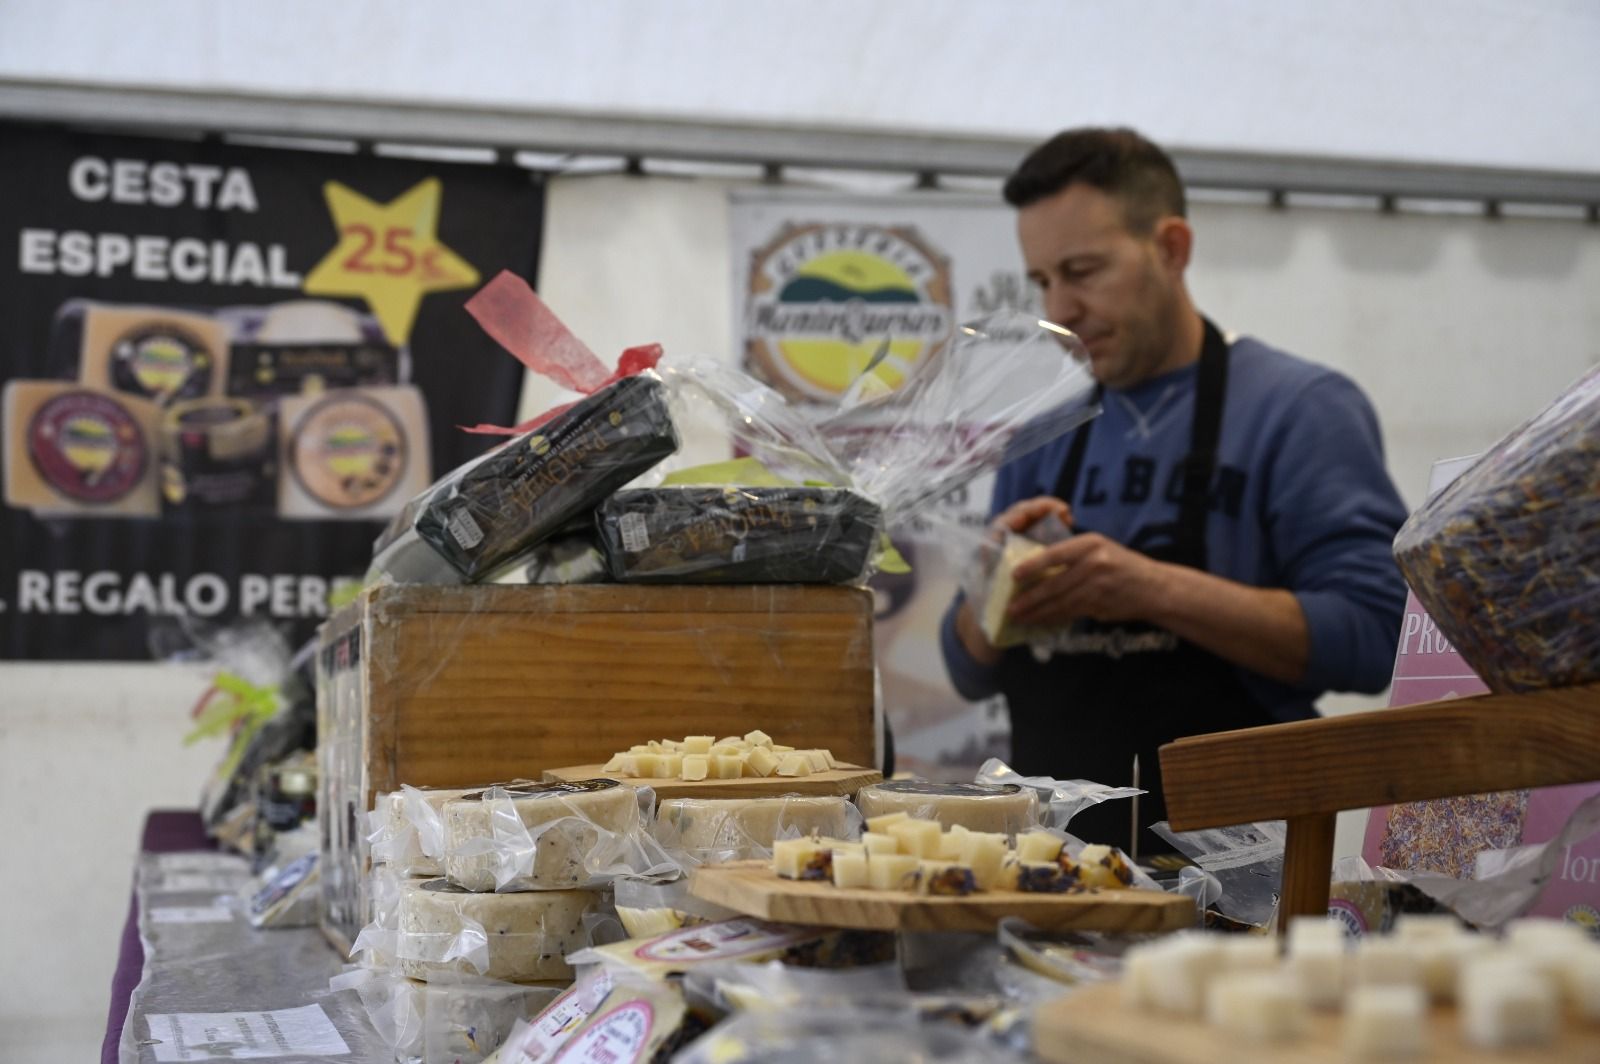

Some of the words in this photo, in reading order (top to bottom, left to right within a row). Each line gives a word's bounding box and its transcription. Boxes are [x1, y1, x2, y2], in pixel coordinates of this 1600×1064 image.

[69, 156, 259, 213] CESTA
[19, 229, 303, 288] ESPECIAL
[18, 570, 230, 617] REGALO
